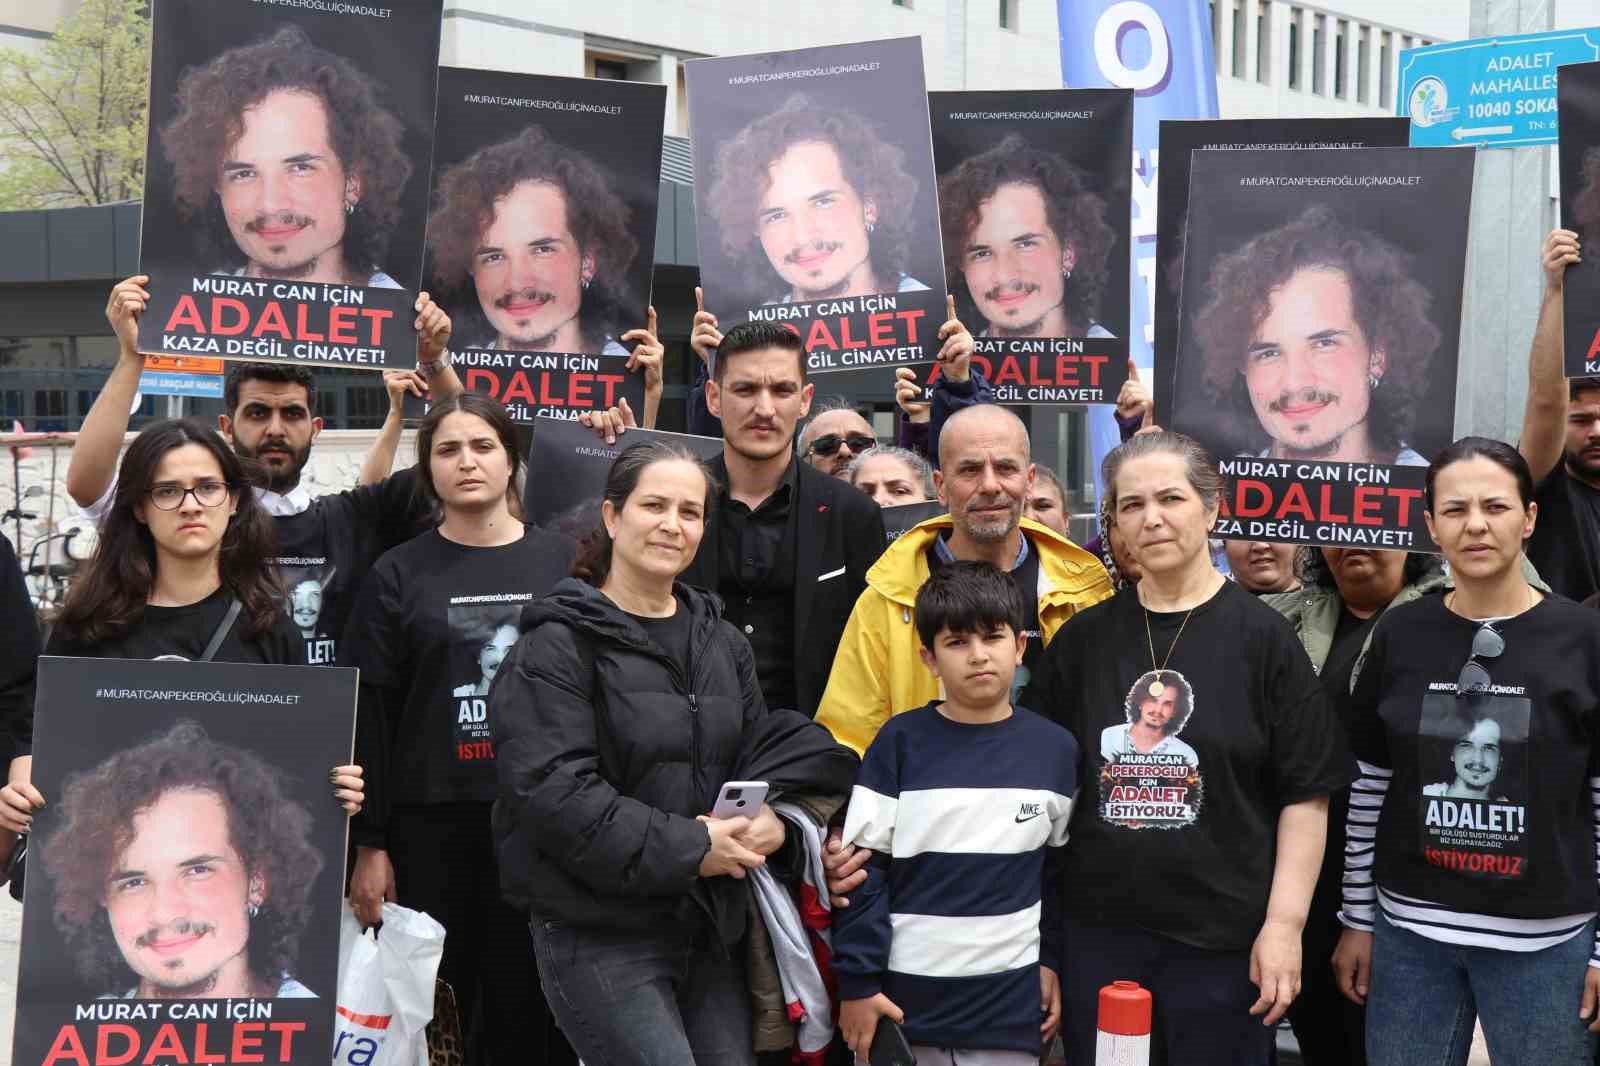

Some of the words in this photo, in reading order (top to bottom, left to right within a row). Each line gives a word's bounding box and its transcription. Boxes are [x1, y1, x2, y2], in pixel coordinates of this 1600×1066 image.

[1486, 52, 1555, 73] ADALET
[1468, 102, 1511, 119] 10040
[1515, 96, 1558, 115] SOKA
[192, 277, 268, 298] MURAT
[272, 283, 317, 301] CAN
[323, 284, 364, 306] İÇİN
[164, 294, 394, 347] ADALET
[748, 304, 812, 323] MURAT
[816, 300, 855, 317] CAN
[860, 296, 897, 314] İÇİN
[783, 309, 926, 353] ALET
[162, 334, 221, 353] KAZA
[226, 337, 288, 358] DEĞİL
[293, 341, 385, 364] CİNAYET!
[807, 351, 837, 369] ĞİL
[841, 346, 924, 366] CİNAYET!
[974, 340, 1006, 353] RAT
[1009, 340, 1044, 353] CAN
[1050, 338, 1084, 356] İÇİN
[451, 350, 516, 367] MURAT
[519, 354, 558, 369] CAN
[563, 353, 600, 373] İÇİN
[927, 355, 1110, 387] DALET
[466, 368, 625, 407] DALET
[992, 385, 1024, 401] EĞİL
[1028, 385, 1104, 401] CİNAYET!
[505, 403, 533, 421] ĞİL
[1218, 460, 1292, 479] MURAT
[1296, 464, 1341, 481] CAN
[1347, 463, 1391, 486] İÇİN
[1213, 518, 1244, 536] ZA
[1249, 519, 1311, 540] DEĞİL
[1315, 522, 1414, 546] CİNAYET!
[307, 640, 336, 664] LET!
[1119, 755, 1183, 765] MURATCAN
[1109, 786, 1188, 804] ADALET
[1020, 803, 1041, 815] NIKE
[1425, 799, 1525, 834] ADALET!
[1425, 846, 1522, 876] İSTİYORUZ
[75, 1002, 162, 1021] MURAT
[168, 1002, 218, 1020] CAN
[225, 998, 273, 1023] İÇİN
[41, 1022, 306, 1066] ADALET
